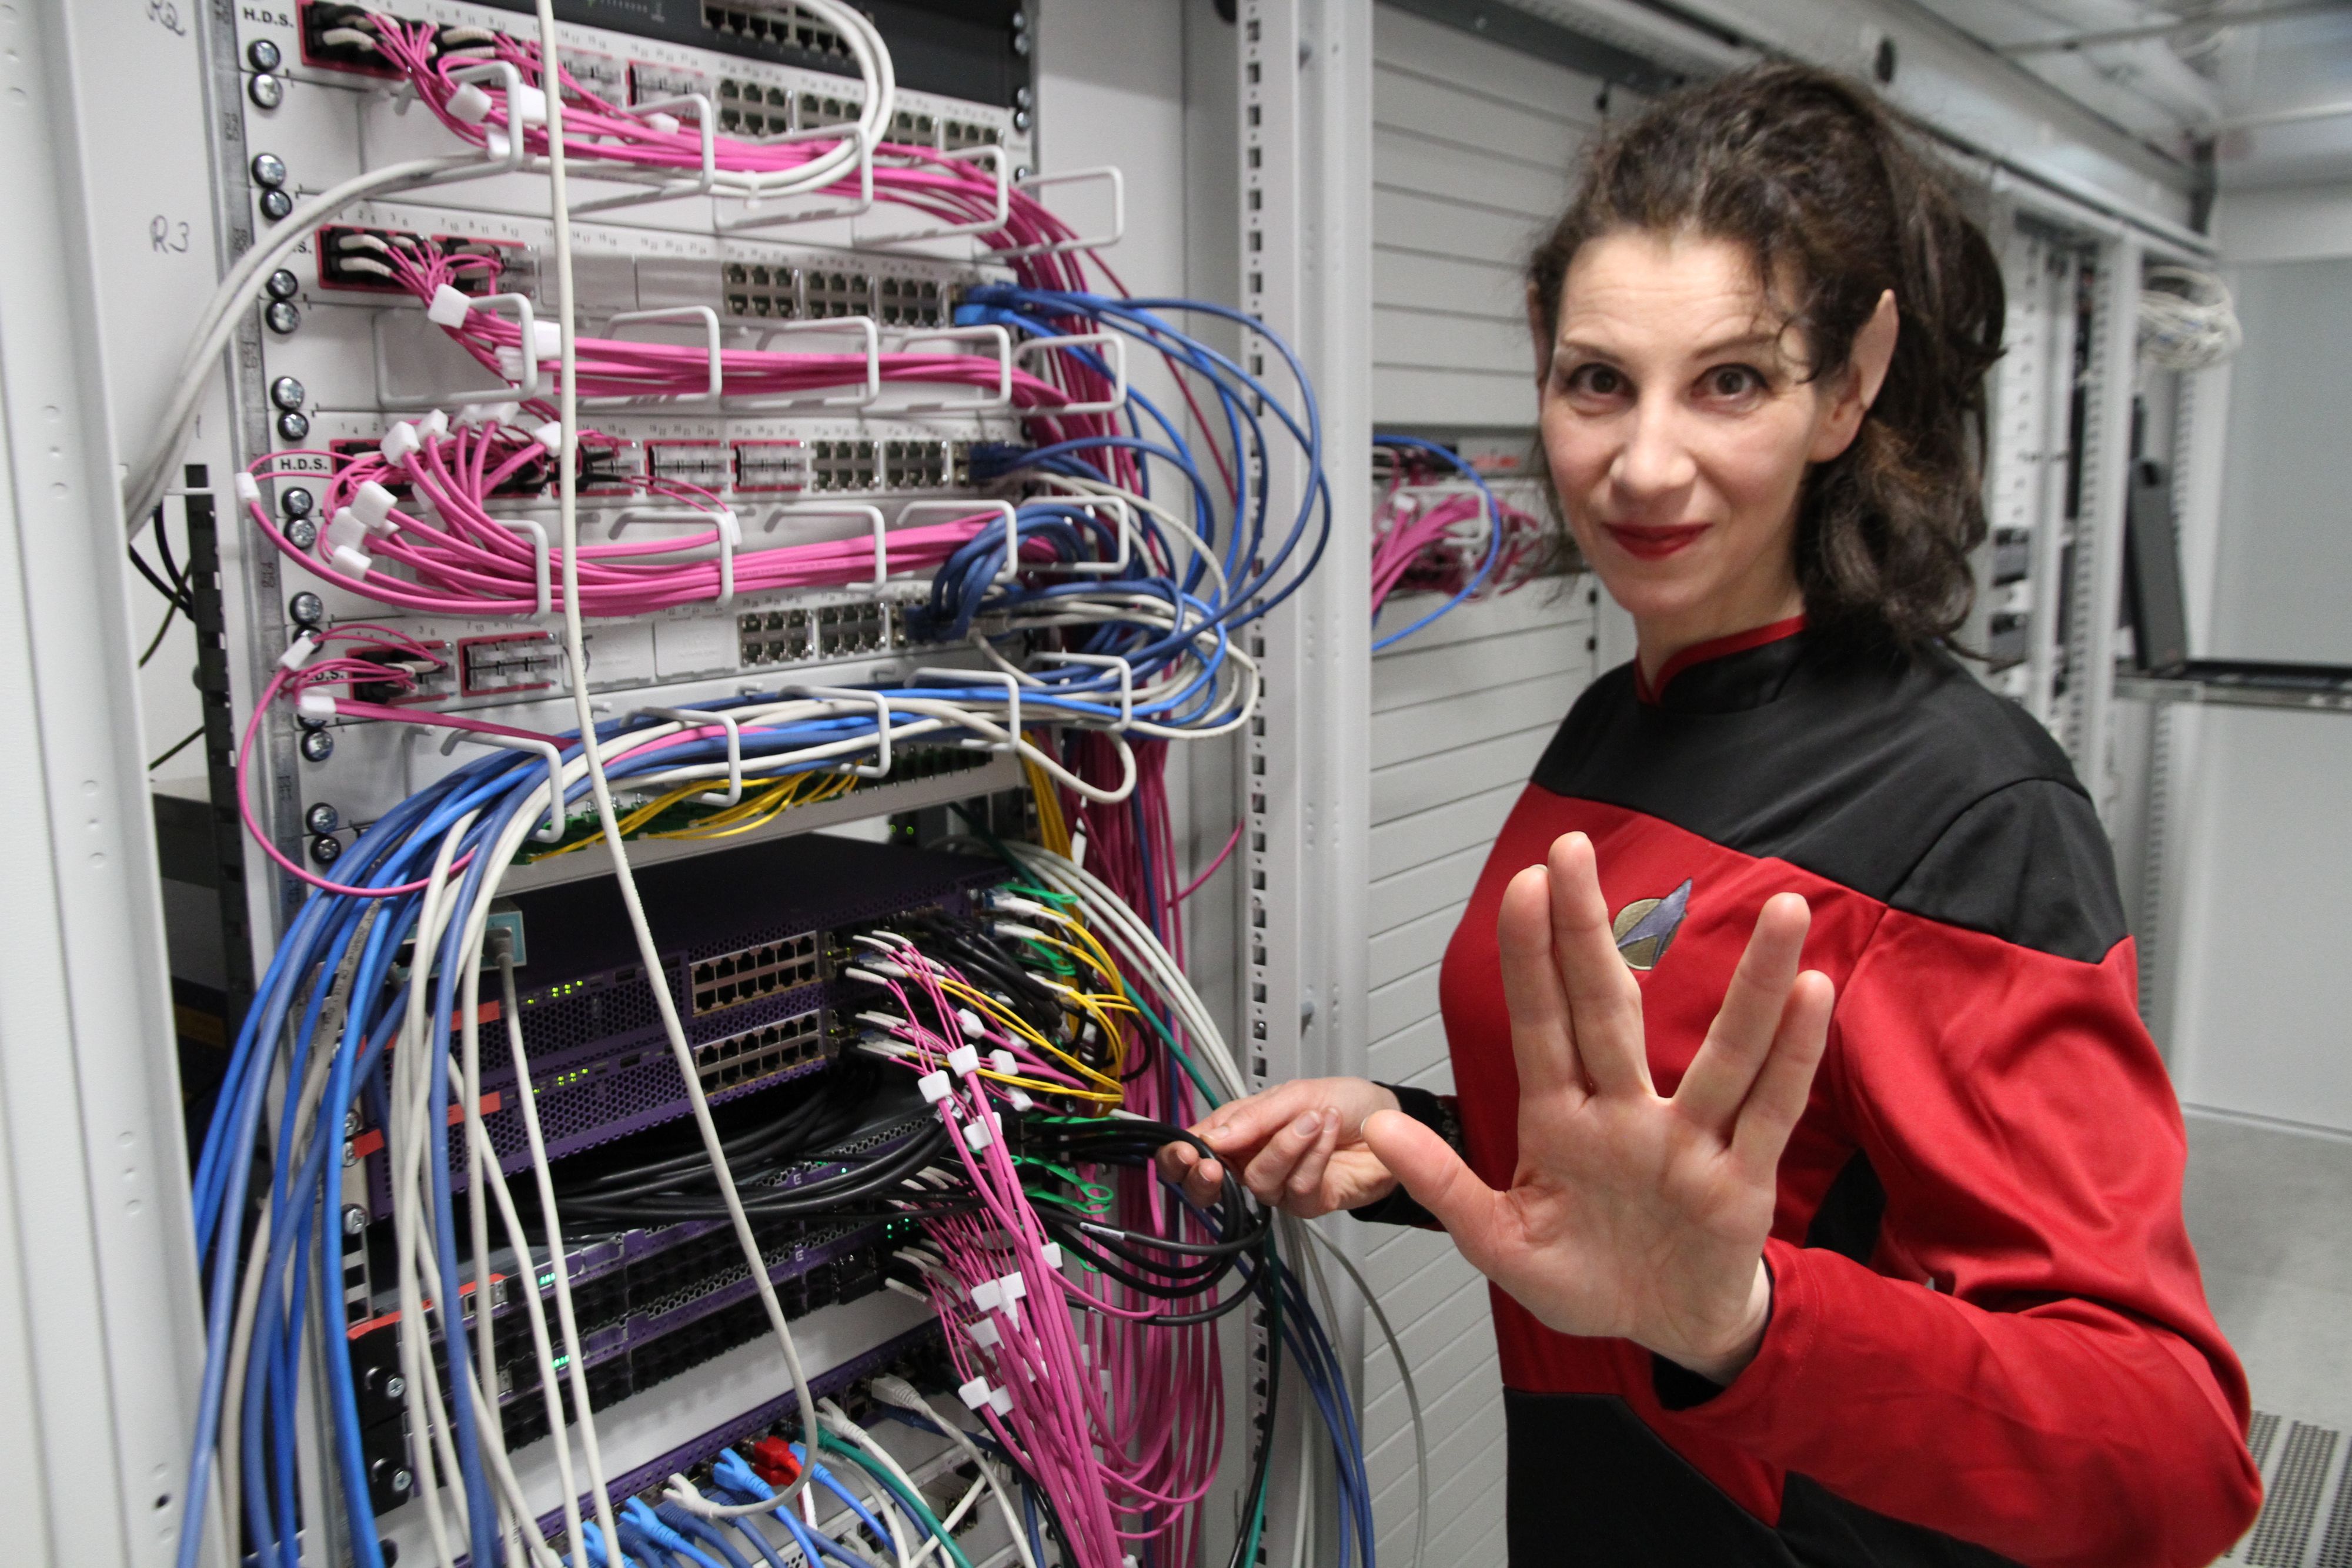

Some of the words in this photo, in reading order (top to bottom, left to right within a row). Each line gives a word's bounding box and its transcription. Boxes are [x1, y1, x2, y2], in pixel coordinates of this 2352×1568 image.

[243, 6, 294, 28] H.D.S.
[149, 215, 190, 254] R3
[280, 458, 327, 470] H.D.S.
